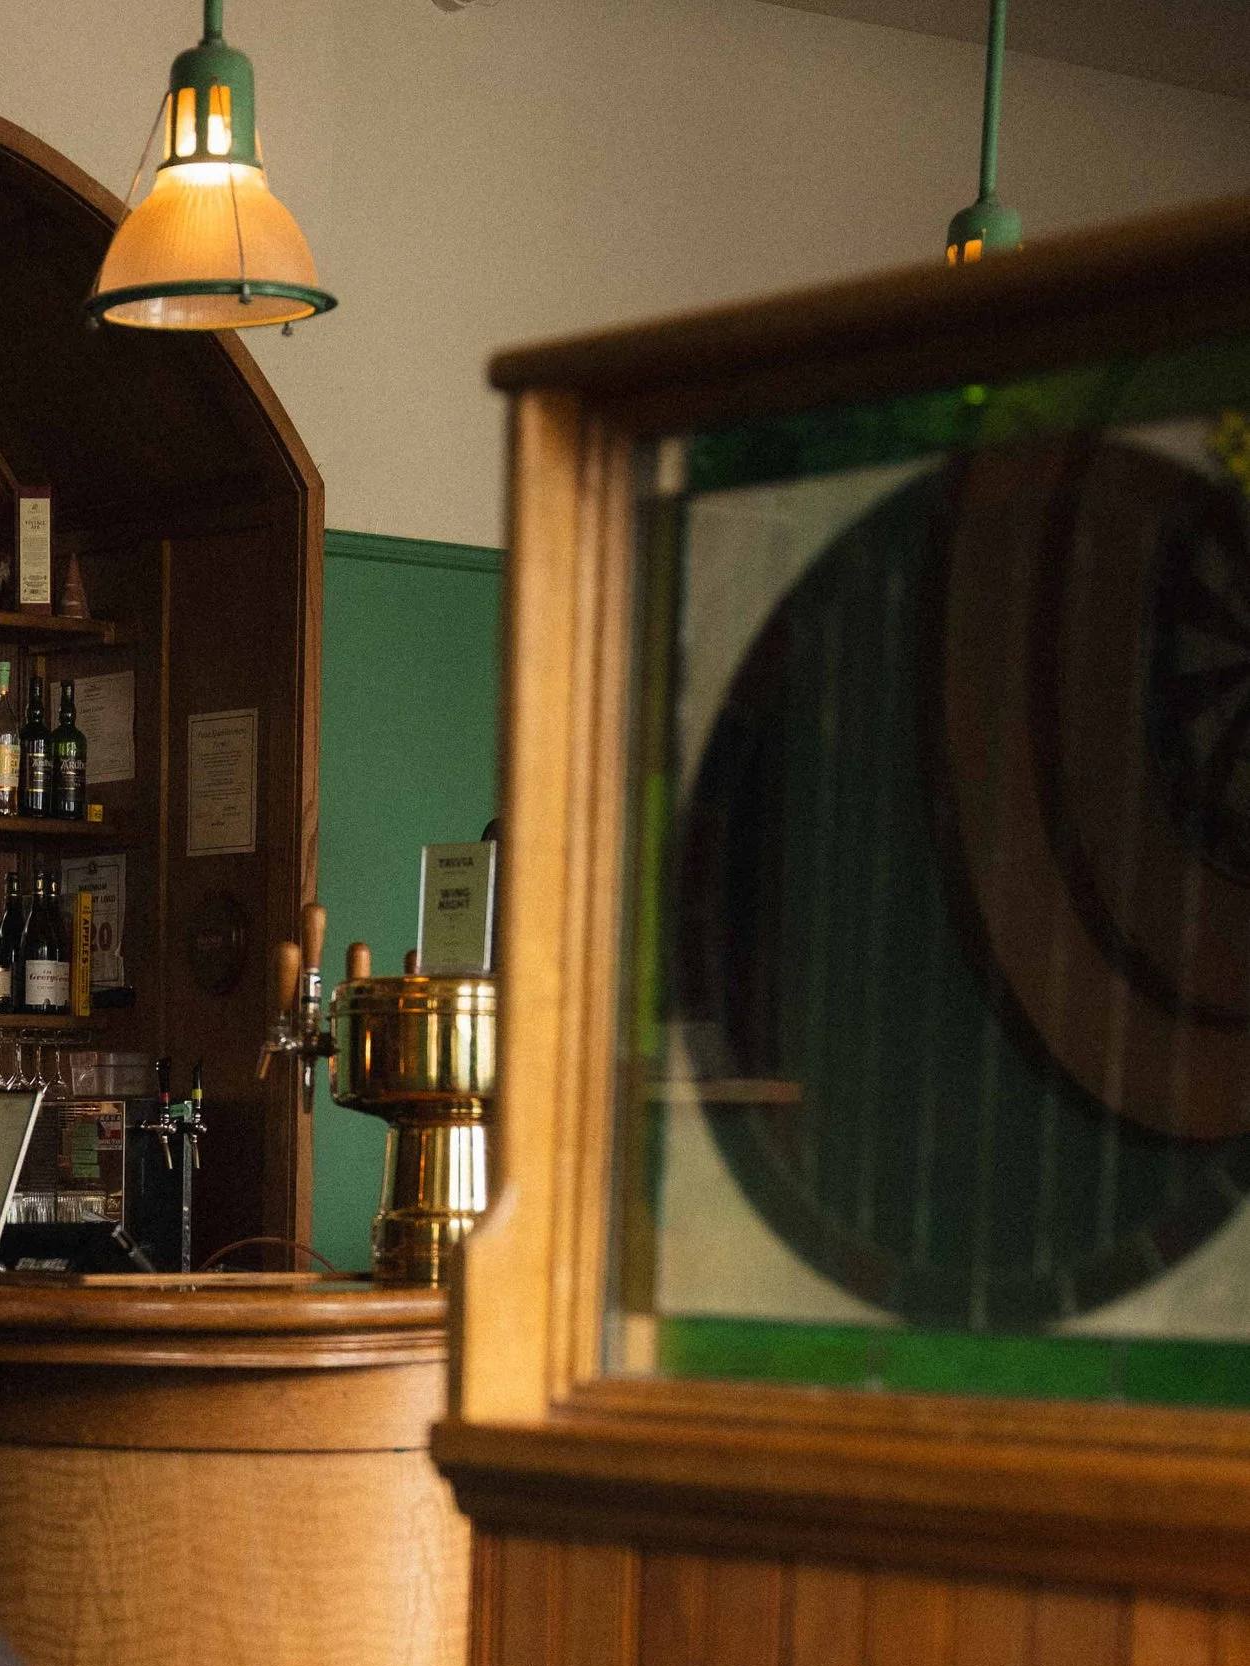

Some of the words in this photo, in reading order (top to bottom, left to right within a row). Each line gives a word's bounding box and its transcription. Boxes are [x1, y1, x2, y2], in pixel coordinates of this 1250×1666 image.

[438, 857, 474, 867] TRIVIA
[78, 883, 108, 892] MAXIMUM
[99, 895, 116, 903] LOAD
[81, 918, 90, 964] APPLES
